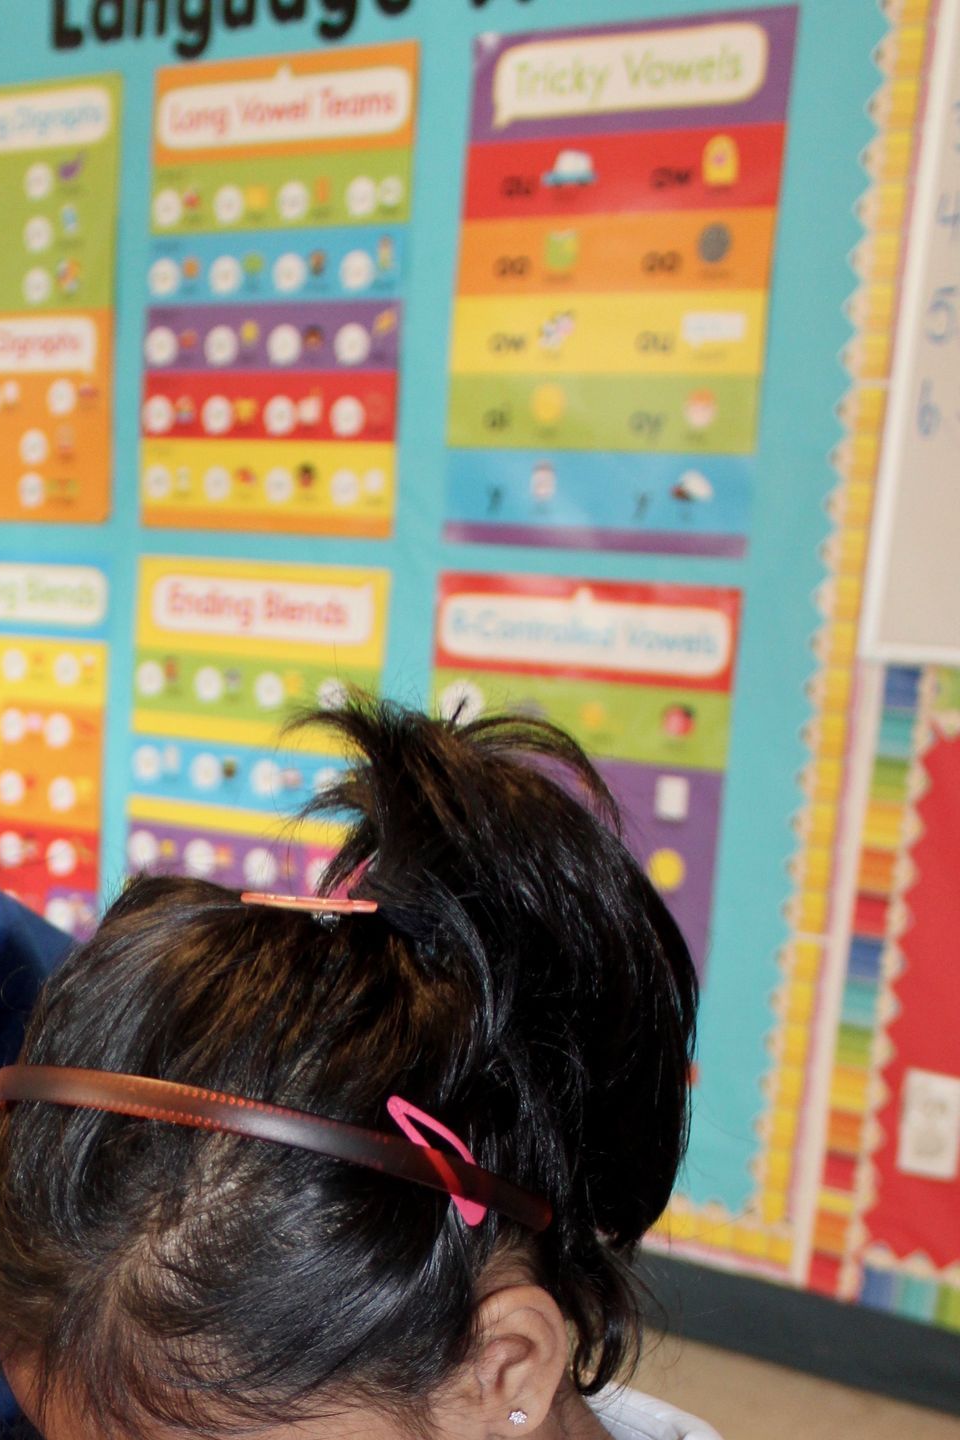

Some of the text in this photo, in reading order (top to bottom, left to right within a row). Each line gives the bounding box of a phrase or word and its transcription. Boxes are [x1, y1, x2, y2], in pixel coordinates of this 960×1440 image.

[514, 47, 743, 99] Tricky Vowels
[168, 584, 349, 627] Ending Blends
